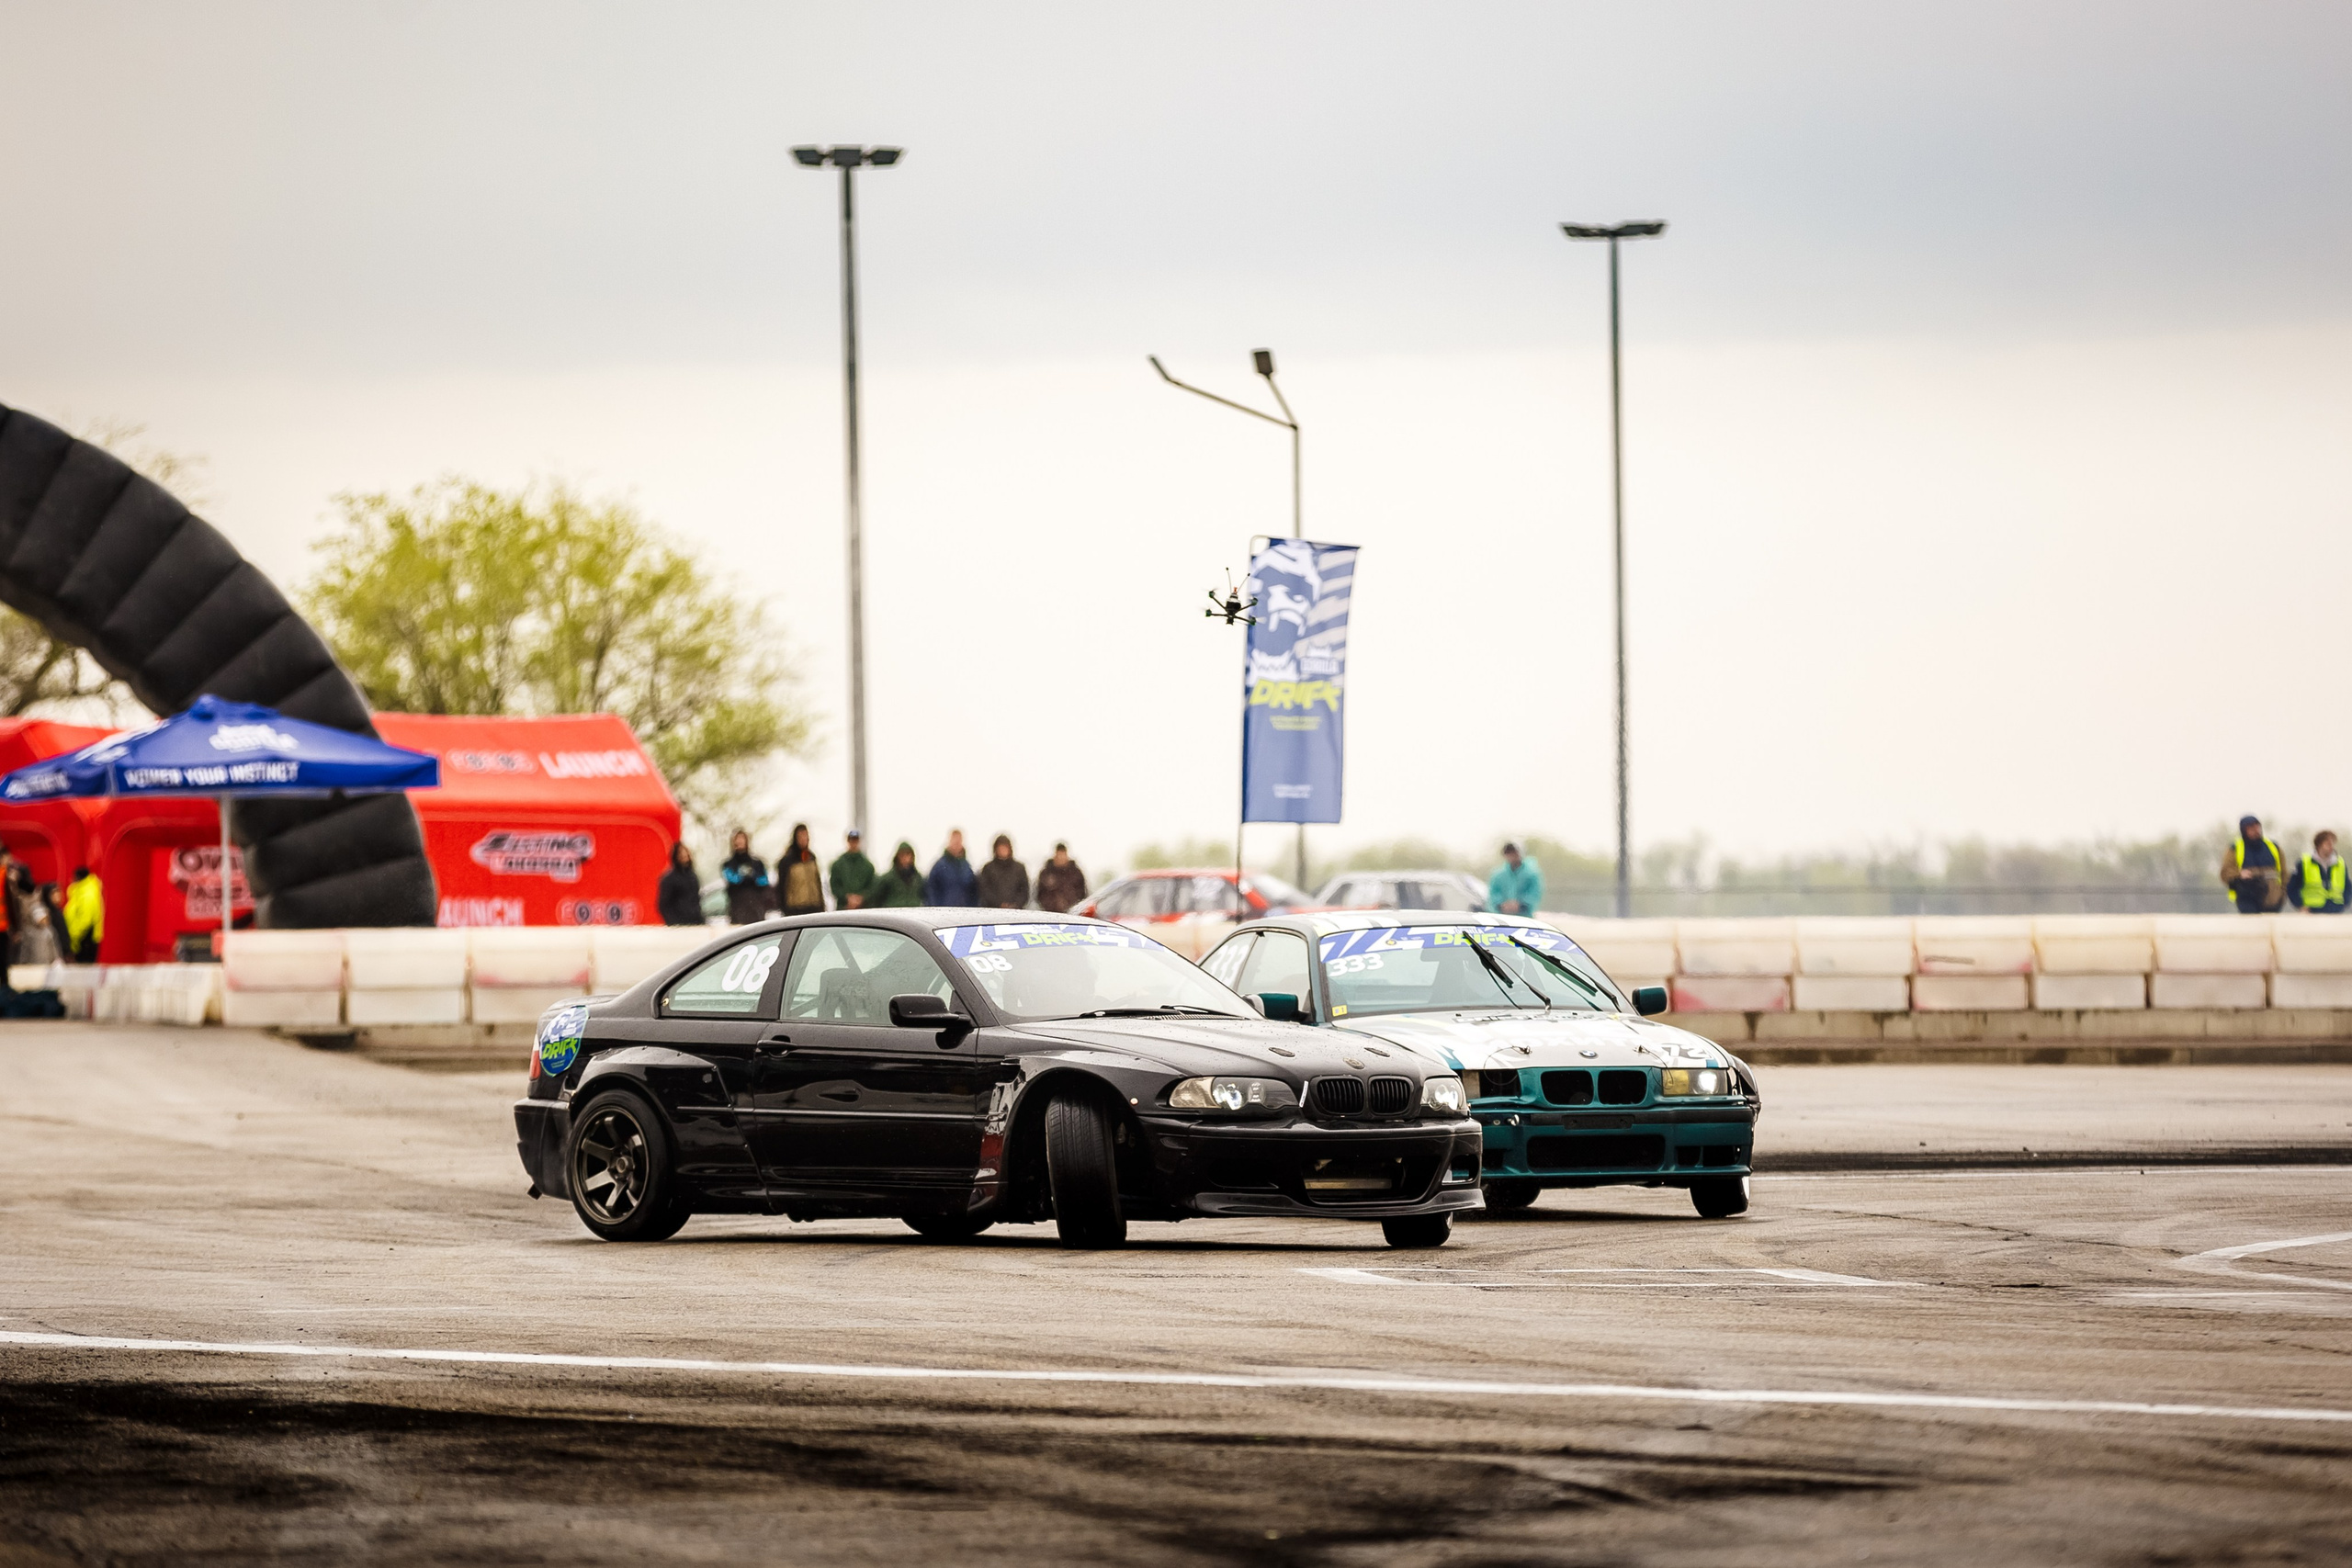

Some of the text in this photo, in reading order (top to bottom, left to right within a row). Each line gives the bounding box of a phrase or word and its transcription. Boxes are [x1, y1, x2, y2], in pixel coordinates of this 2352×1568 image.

[1250, 679, 1341, 712] DRIFT
[184, 765, 229, 786] YOUR
[230, 761, 299, 783] INSTINCT
[538, 750, 647, 778] LAUNCH
[437, 897, 525, 926] AUNCH
[1021, 932, 1100, 945] DRIFT
[721, 944, 780, 993] 08
[968, 954, 1012, 974] 08
[1329, 953, 1385, 977] 333
[541, 1037, 578, 1060] DRIFT
